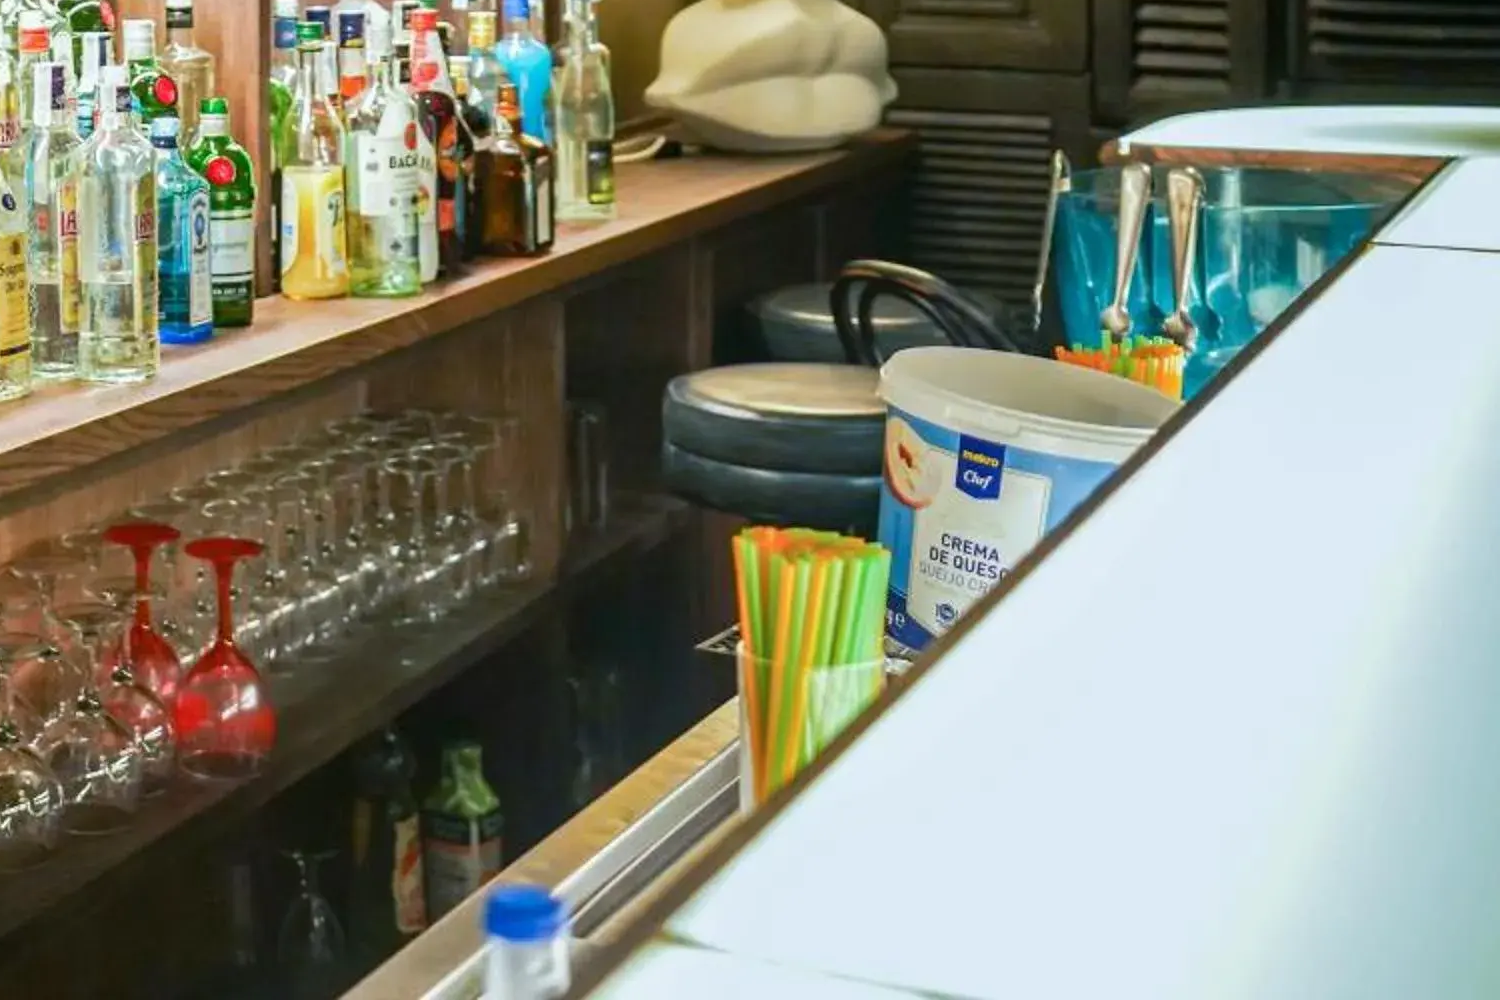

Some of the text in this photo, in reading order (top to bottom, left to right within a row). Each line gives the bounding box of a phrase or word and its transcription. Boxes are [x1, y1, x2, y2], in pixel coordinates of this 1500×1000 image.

[963, 449, 1000, 468] makro
[963, 469, 993, 491] Chef
[929, 545, 948, 566] DE
[941, 533, 999, 562] CREMA
[919, 561, 965, 588] QUEIJO
